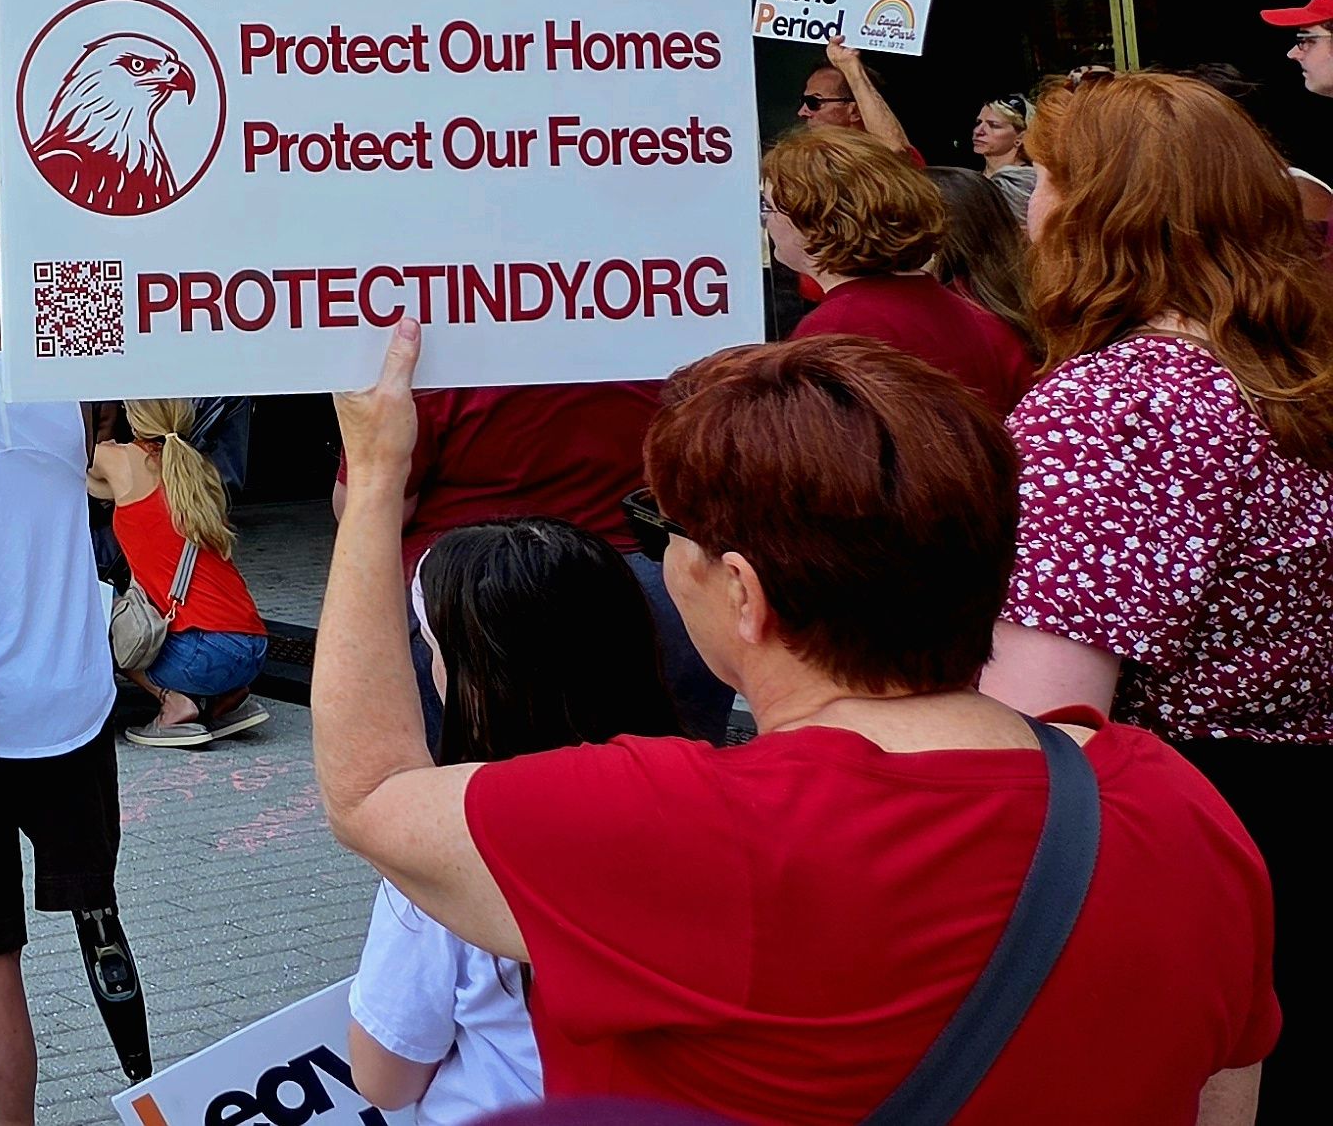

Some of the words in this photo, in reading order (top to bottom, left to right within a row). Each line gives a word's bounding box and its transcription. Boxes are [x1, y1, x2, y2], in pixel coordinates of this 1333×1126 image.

[755, 3, 845, 41] Period
[860, 25, 886, 37] Creek
[889, 28, 915, 40] Park
[877, 15, 903, 30] Eagle
[240, 23, 429, 74] Protect
[440, 20, 533, 73] Our
[545, 20, 721, 71] Homes
[244, 121, 432, 172] Protect
[442, 117, 536, 170] Our
[548, 116, 732, 167] Forests
[138, 256, 729, 333] PROTECTINDY.ORG
